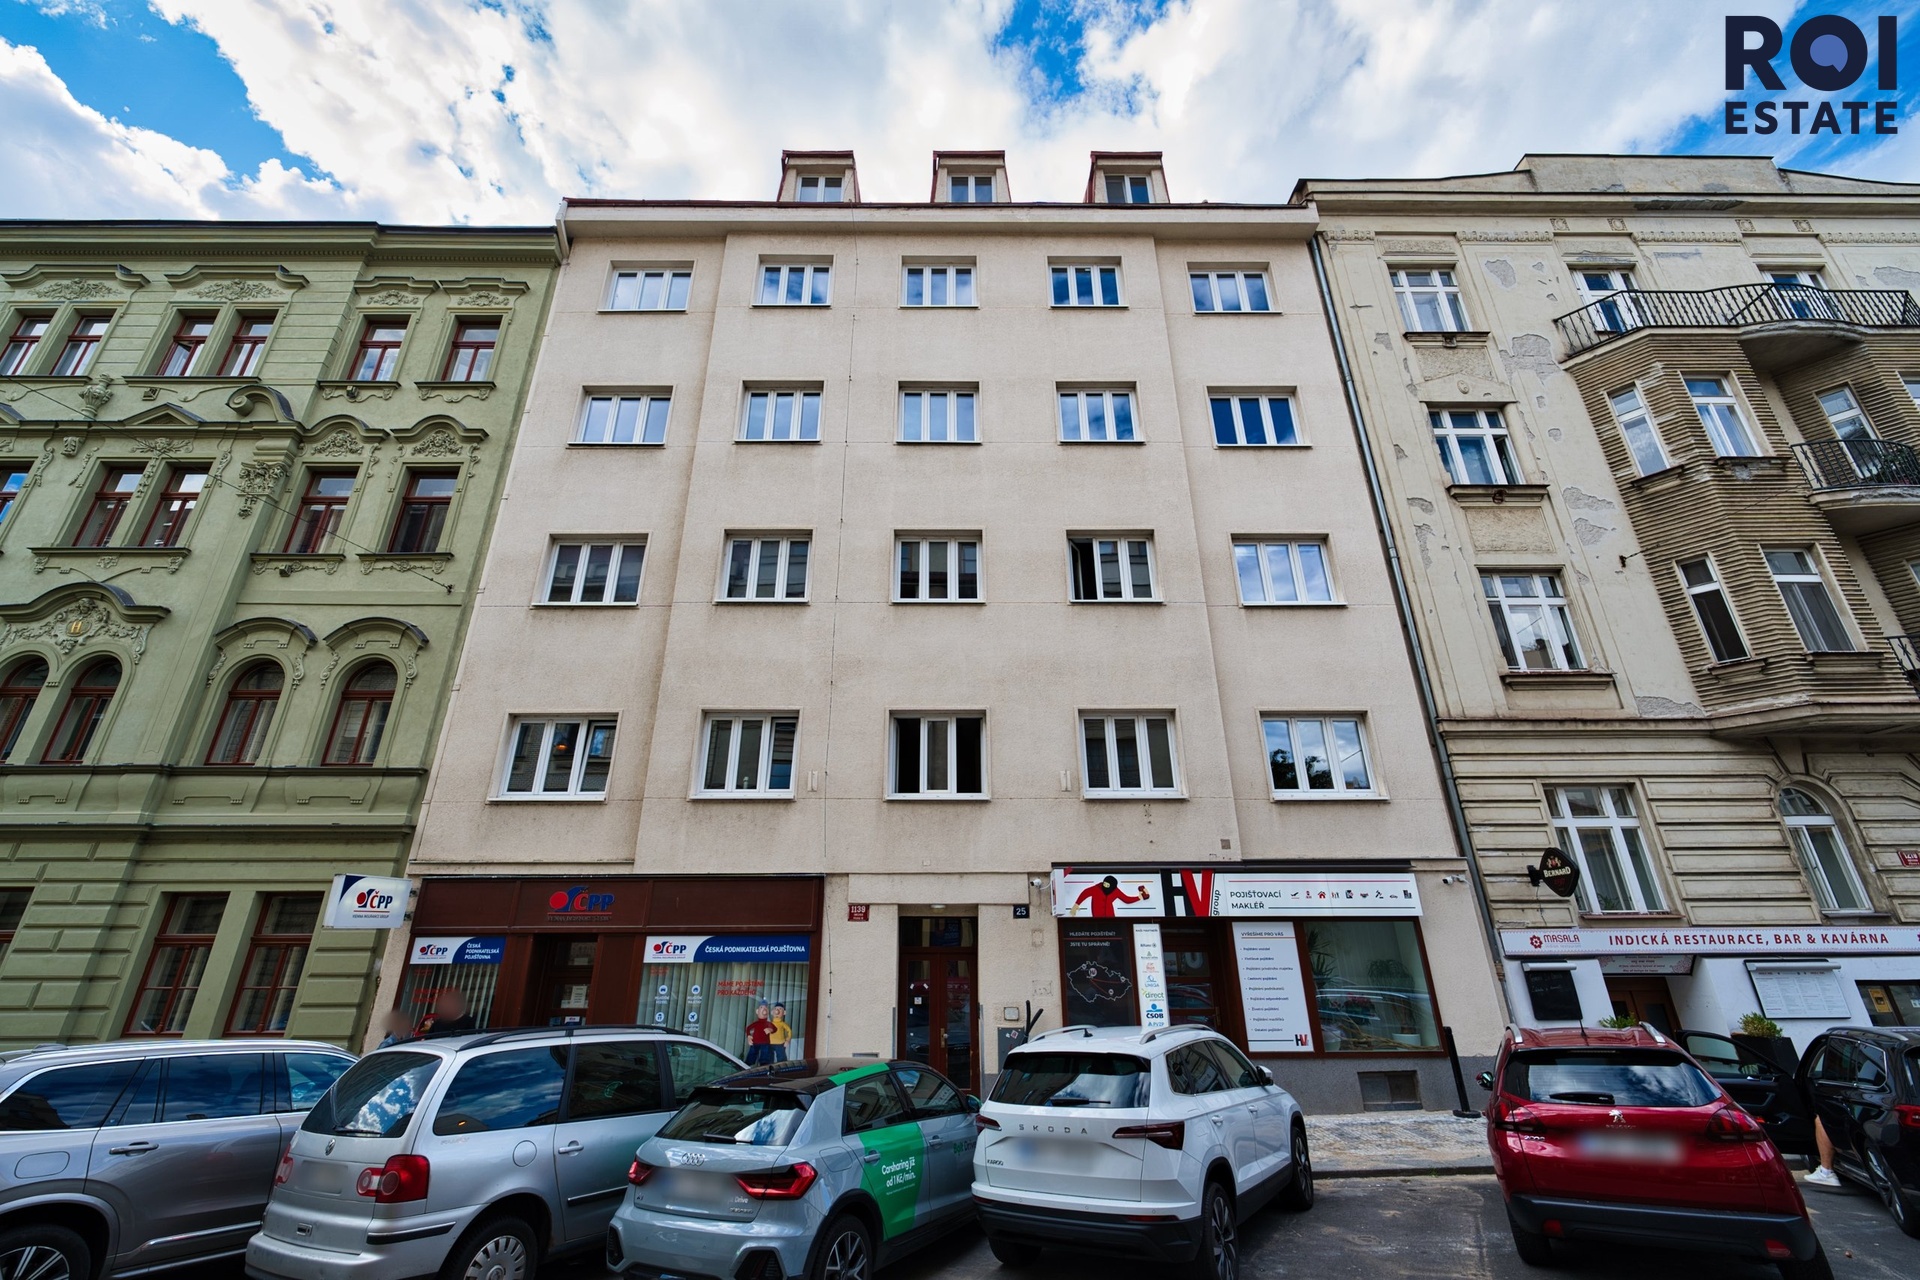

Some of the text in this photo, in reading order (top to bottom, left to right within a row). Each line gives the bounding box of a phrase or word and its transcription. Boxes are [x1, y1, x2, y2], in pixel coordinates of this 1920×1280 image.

[1543, 866, 1571, 878] BERNARD
[1160, 868, 1215, 917] HV
[1230, 890, 1282, 898] POJIŠŤOVACÍ
[369, 890, 393, 909] ČPP
[1212, 889, 1222, 917] group
[851, 905, 866, 913] 1139
[1016, 907, 1026, 915] 25
[1231, 902, 1265, 910] MAKLÉŘ
[1543, 934, 1581, 943] MASALA
[1609, 931, 1889, 946] INDICKÁ RESTAURACE, BAR & KAVÁRNA
[429, 944, 448, 955] ČPP
[667, 942, 687, 953] ČPP
[704, 944, 806, 953] ČESKÁ PODNIKATELSKÁ POJIŠŤOVNA
[1145, 991, 1164, 999] direct
[881, 1160, 910, 1175] Carsharing
[886, 1176, 893, 1188] od
